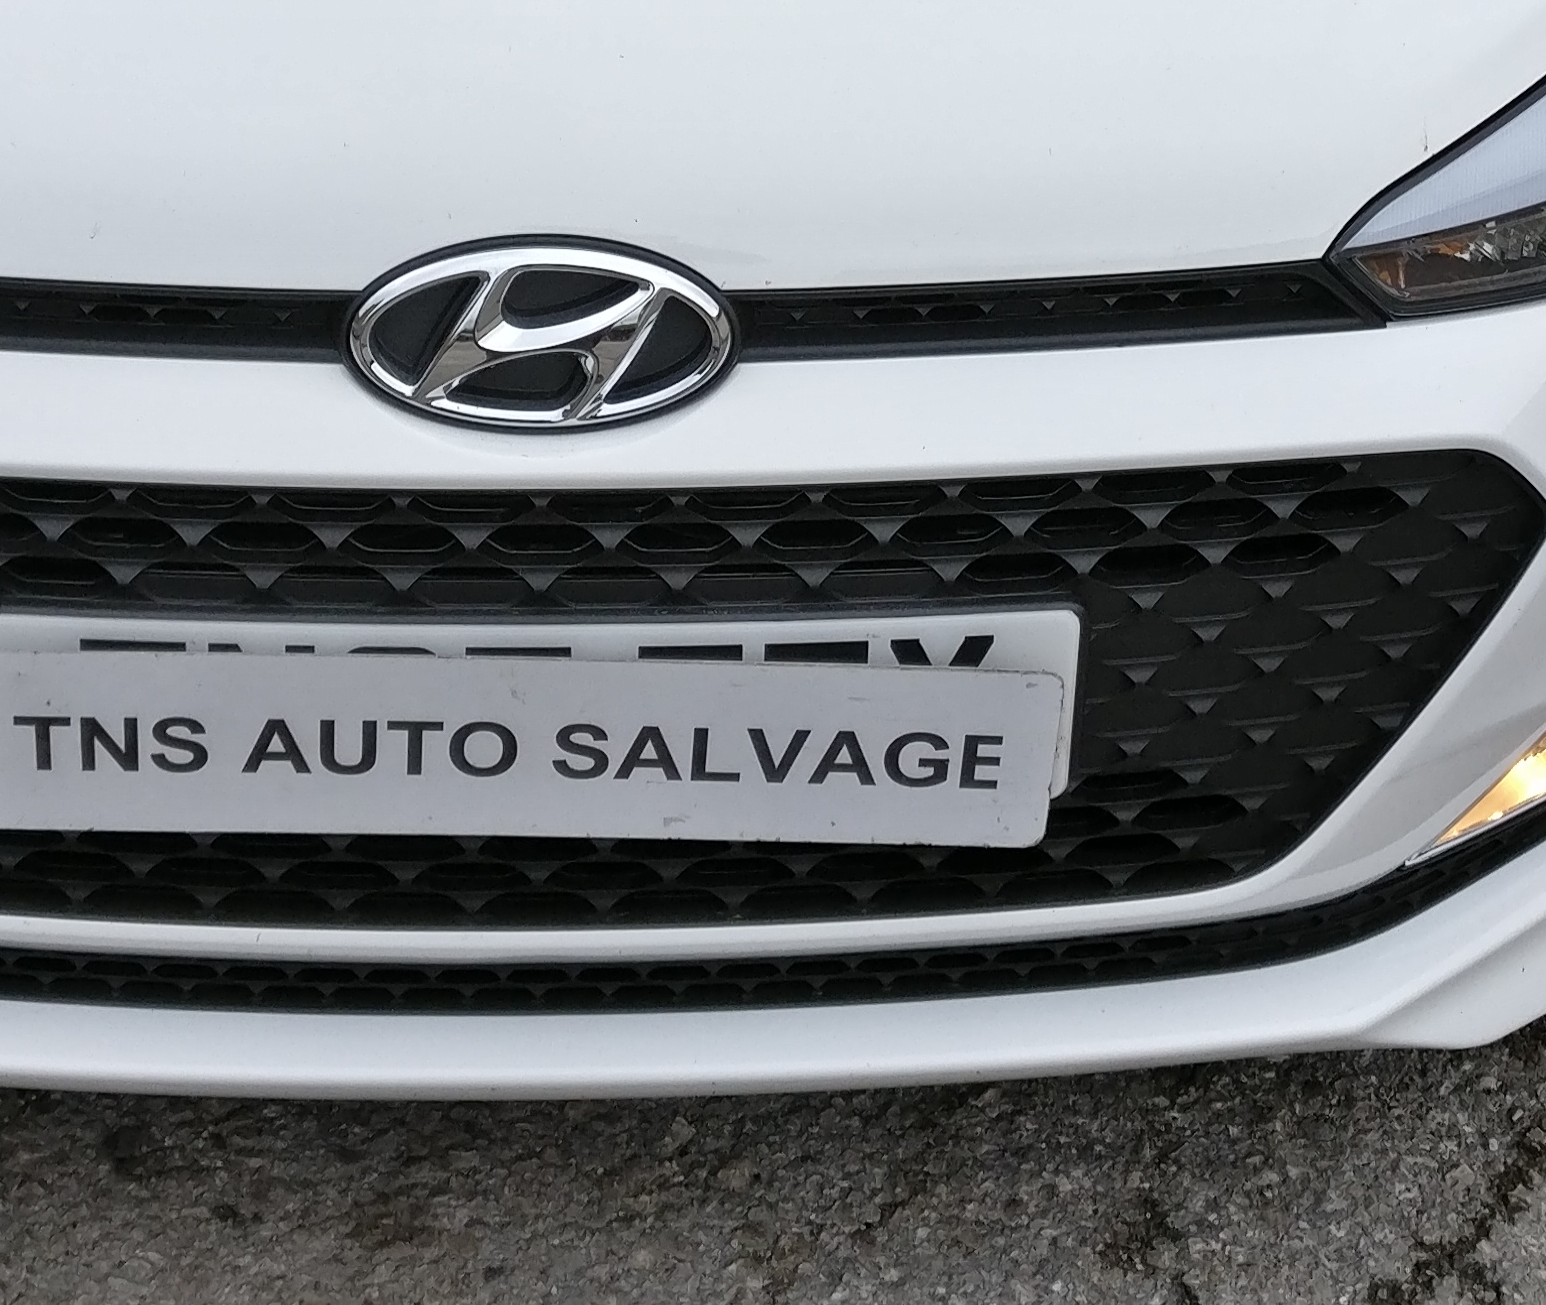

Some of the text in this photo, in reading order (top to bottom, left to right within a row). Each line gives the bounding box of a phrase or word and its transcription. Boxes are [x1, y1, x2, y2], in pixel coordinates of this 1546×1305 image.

[13, 715, 1004, 790] TNS AUTO SALVAGE
